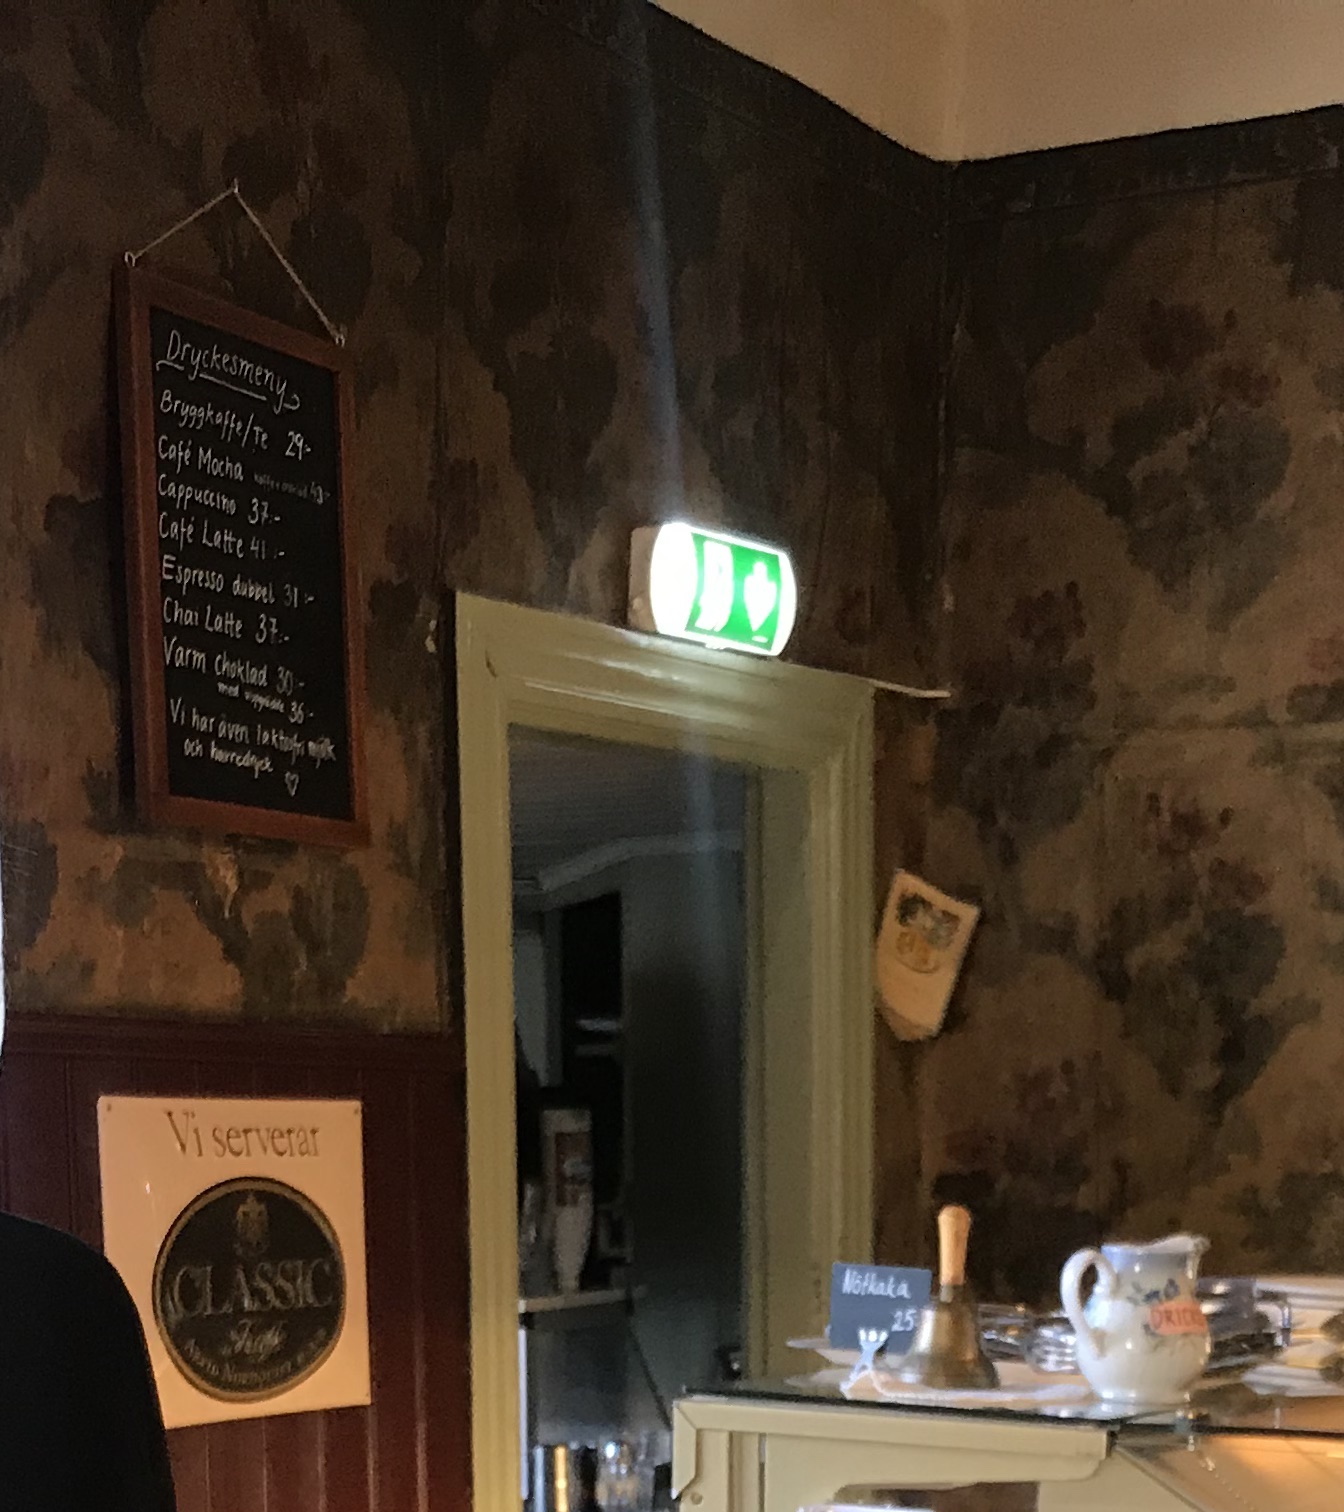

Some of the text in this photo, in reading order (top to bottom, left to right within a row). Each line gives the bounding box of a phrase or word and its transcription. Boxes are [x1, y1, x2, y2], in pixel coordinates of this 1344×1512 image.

[167, 330, 291, 415] Dryckesmeny
[158, 435, 192, 475] Café
[198, 446, 245, 482] Mocha
[158, 474, 237, 516] Cappuccino
[158, 512, 195, 552] Café
[201, 519, 245, 558] Latte
[161, 554, 224, 596] Espresso
[163, 596, 199, 627] Chai
[204, 604, 243, 639] Latte
[163, 635, 206, 674] Varm
[169, 697, 186, 726] Vi
[191, 707, 216, 733] har
[163, 1108, 320, 1158] Vi serverar
[174, 1259, 336, 1317] CLASSIC
[890, 1307, 917, 1332] 25
